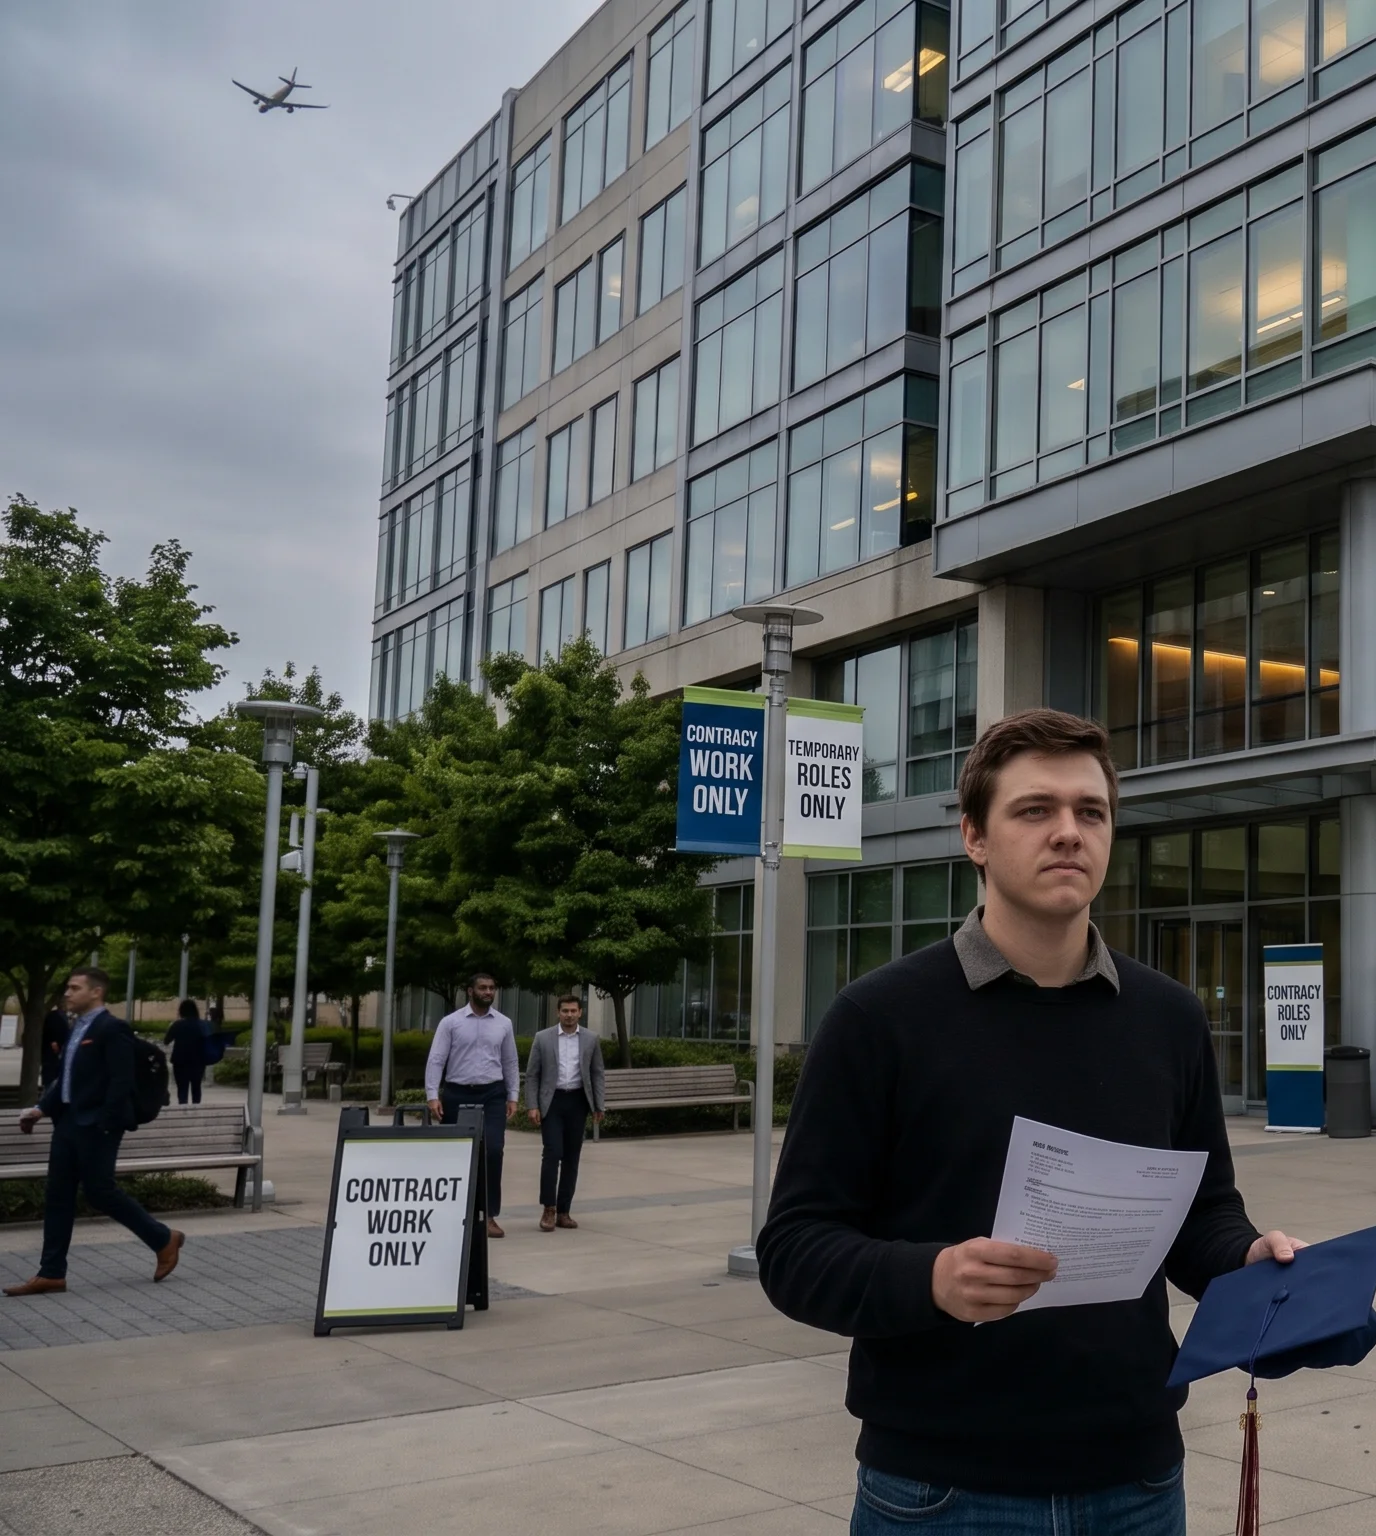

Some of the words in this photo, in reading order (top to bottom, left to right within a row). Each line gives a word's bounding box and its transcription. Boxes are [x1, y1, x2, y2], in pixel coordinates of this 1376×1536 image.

[686, 724, 758, 748] CONTRACY
[788, 739, 860, 761] TEMPORARY
[689, 748, 753, 781] WORK
[797, 762, 852, 790] ROLES
[693, 784, 748, 816] ONLY
[800, 793, 846, 820] ONLY
[1267, 984, 1321, 1000] CONTRACY
[1277, 1004, 1310, 1021] ROLES
[1280, 1024, 1307, 1041] ONLY
[345, 1177, 462, 1203] CONTRACT
[367, 1209, 434, 1234] WORK
[368, 1241, 427, 1267] ONLY
